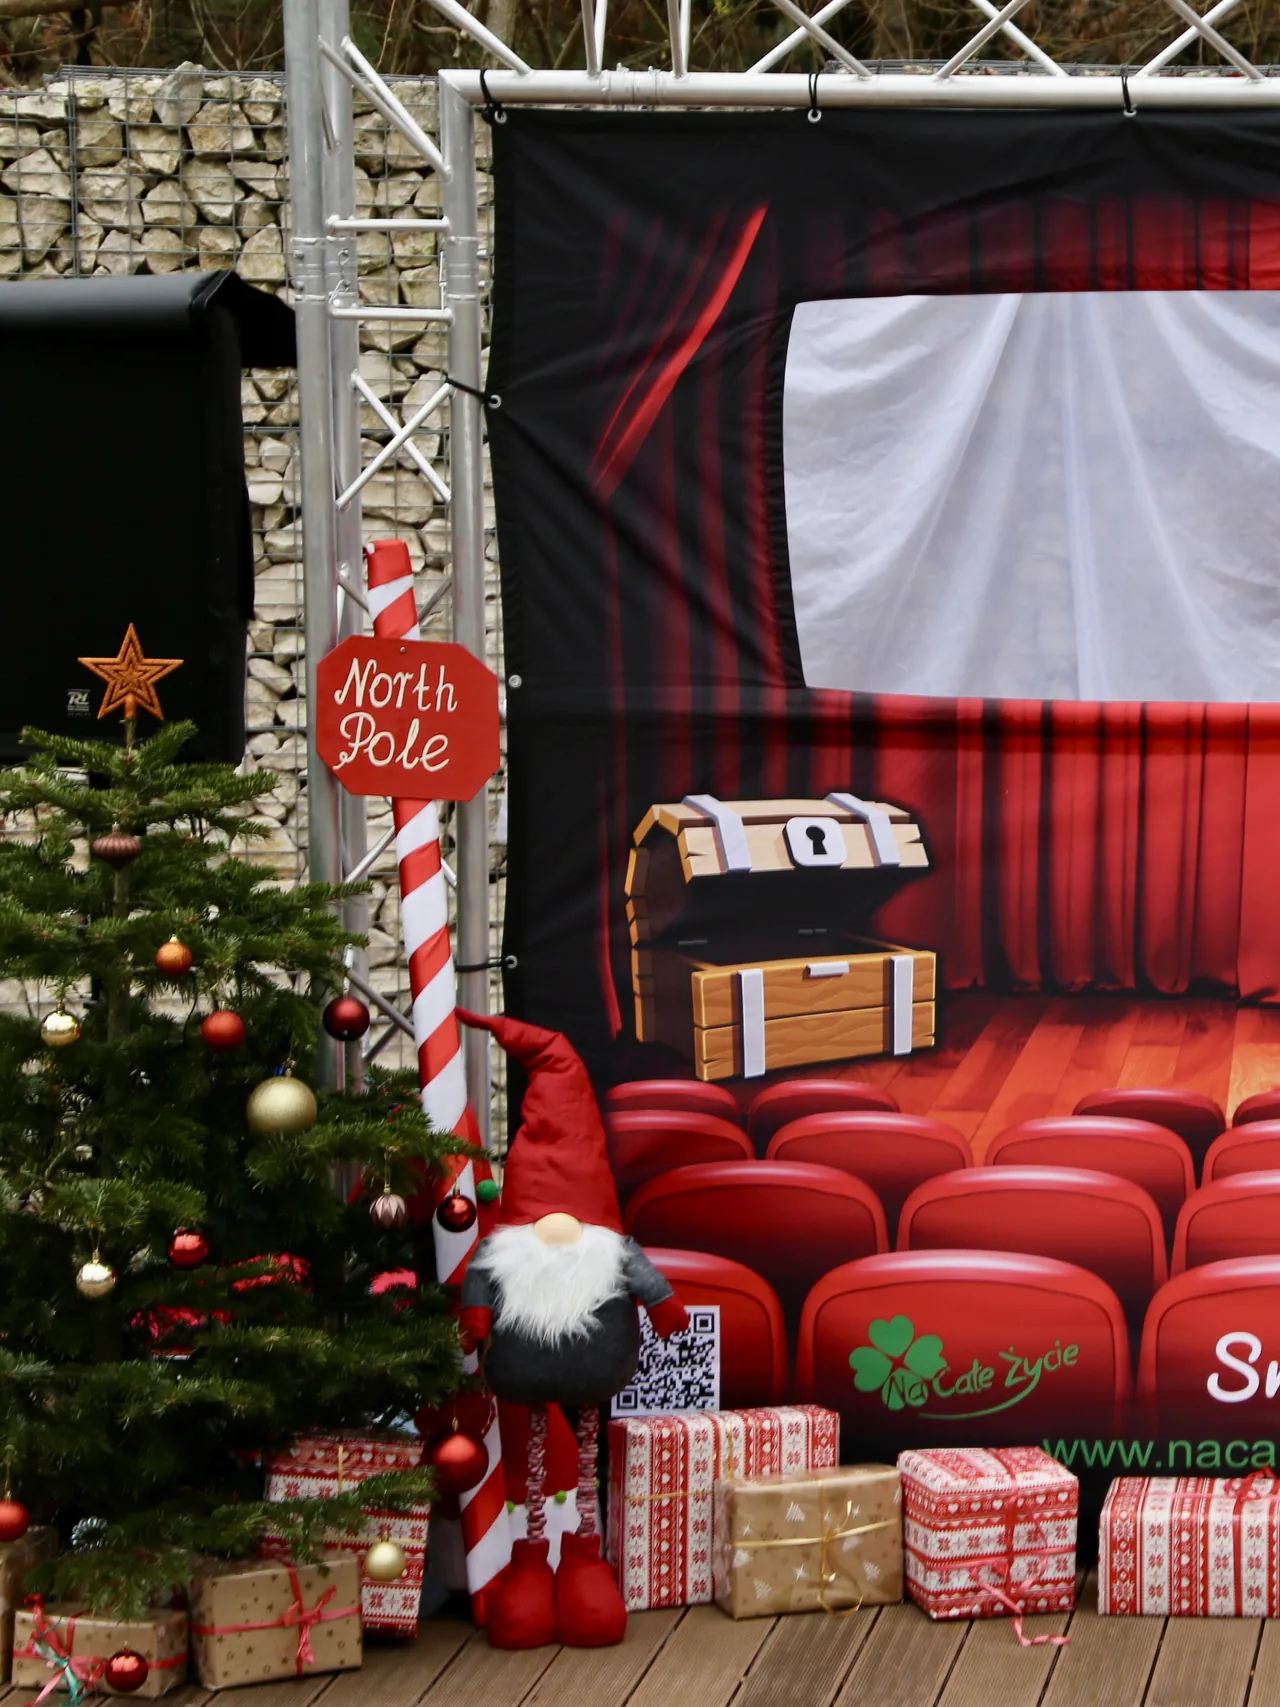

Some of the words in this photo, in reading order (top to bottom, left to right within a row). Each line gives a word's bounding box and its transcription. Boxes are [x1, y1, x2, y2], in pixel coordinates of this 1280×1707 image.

[333, 657, 458, 713] North
[332, 711, 450, 773] Pole
[998, 1339, 1080, 1408] Życie
